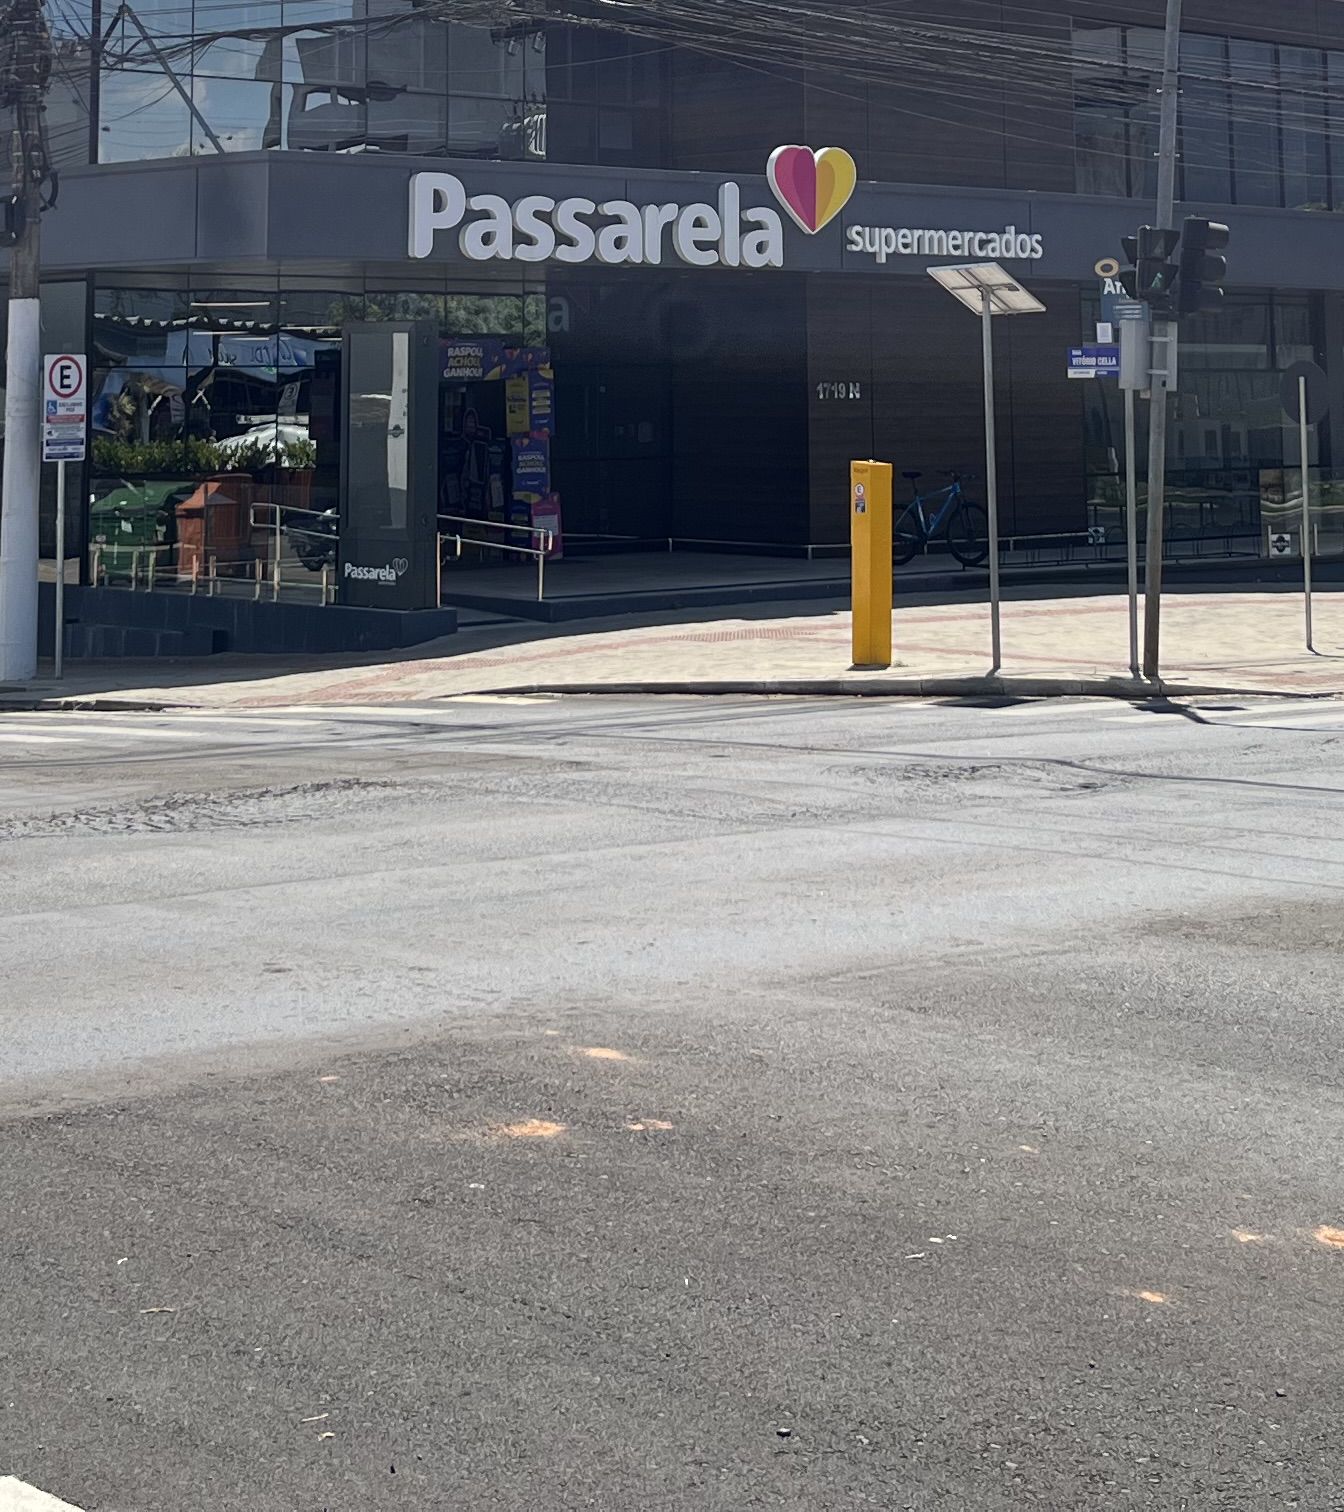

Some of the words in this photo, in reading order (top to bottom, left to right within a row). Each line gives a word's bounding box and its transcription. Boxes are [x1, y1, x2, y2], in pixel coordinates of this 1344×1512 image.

[408, 172, 784, 267] Passarela
[846, 225, 1043, 264] supermercados
[447, 347, 483, 357] RASPOU,
[60, 365, 73, 389] E
[443, 368, 483, 378] GANHOU!
[816, 382, 846, 399] 1719
[344, 562, 396, 581] Passarela
